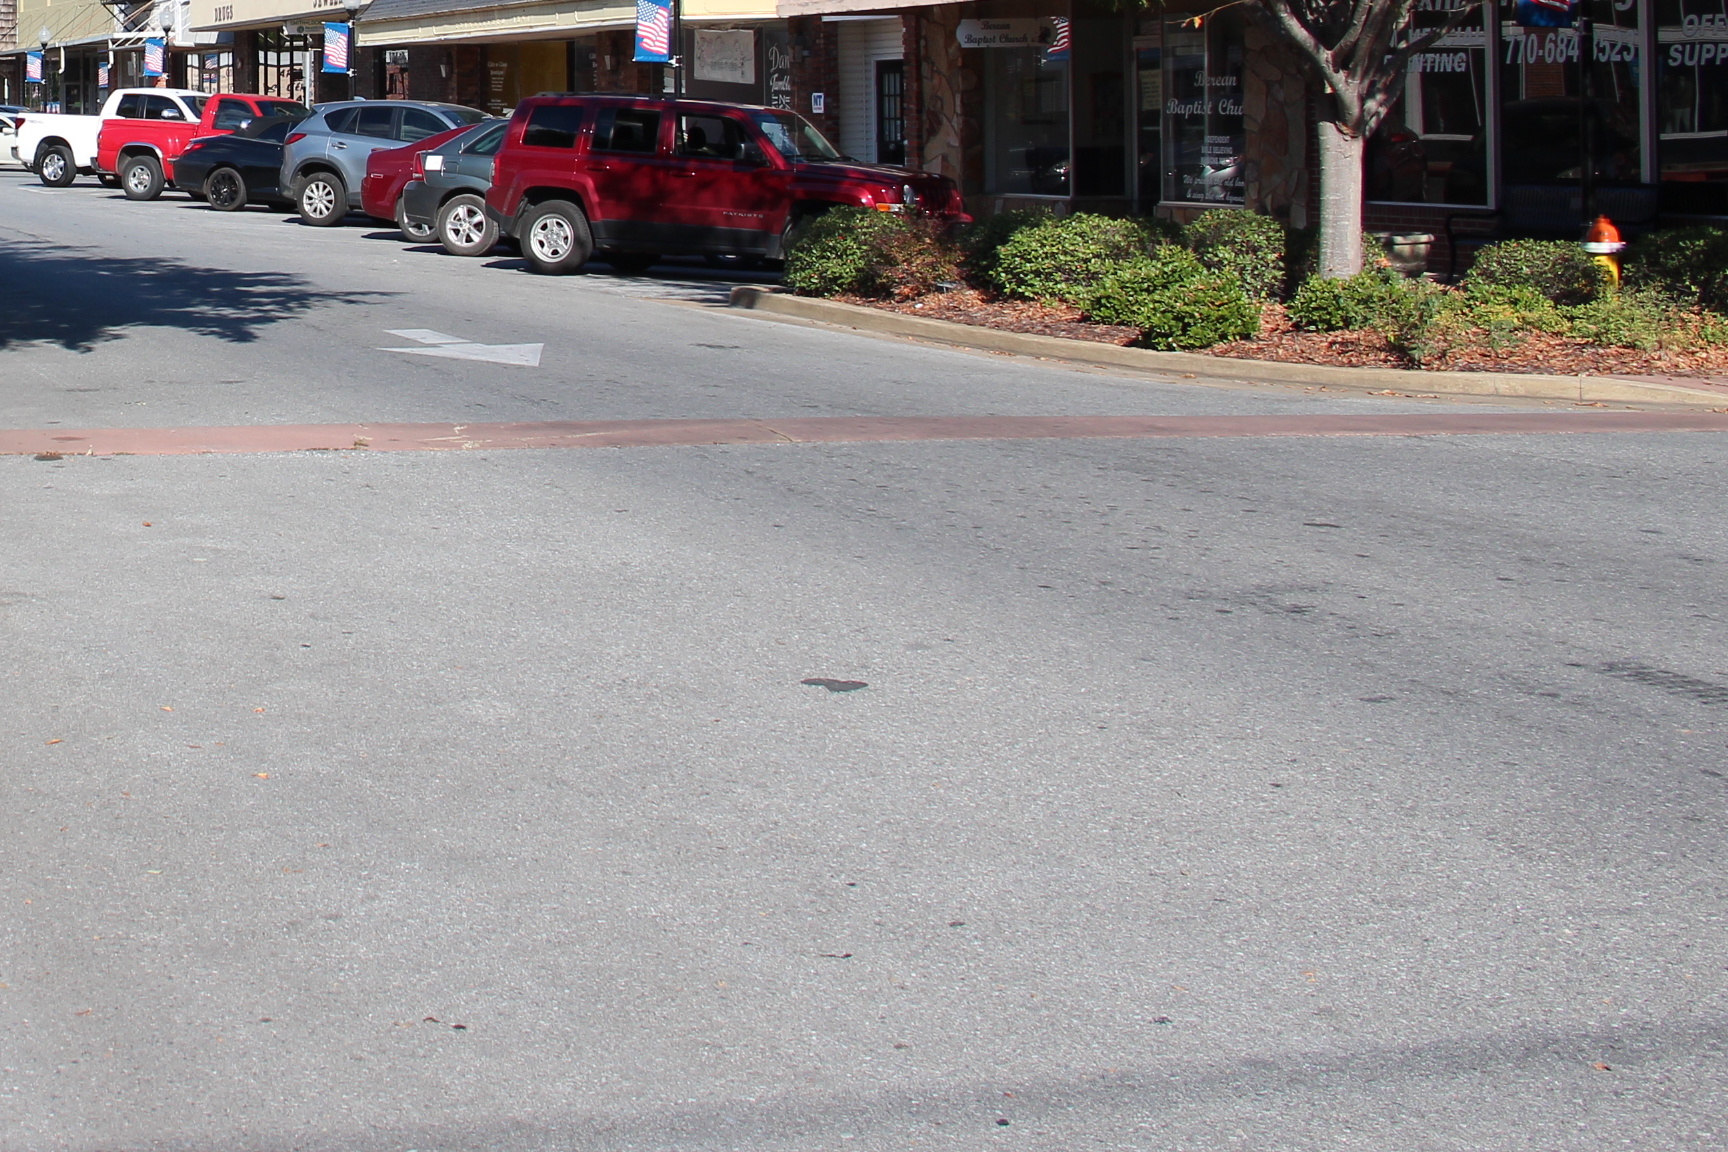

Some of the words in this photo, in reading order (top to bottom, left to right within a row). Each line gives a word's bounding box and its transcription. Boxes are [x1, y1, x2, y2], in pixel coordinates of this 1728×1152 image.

[214, 5, 234, 22] DRUGS
[981, 20, 1011, 30] Berean
[1682, 14, 1728, 38] OFF
[964, 34, 996, 46] Baptist
[999, 33, 1028, 44] Church
[1194, 71, 1237, 87] Berean
[1166, 98, 1212, 119] Baptist
